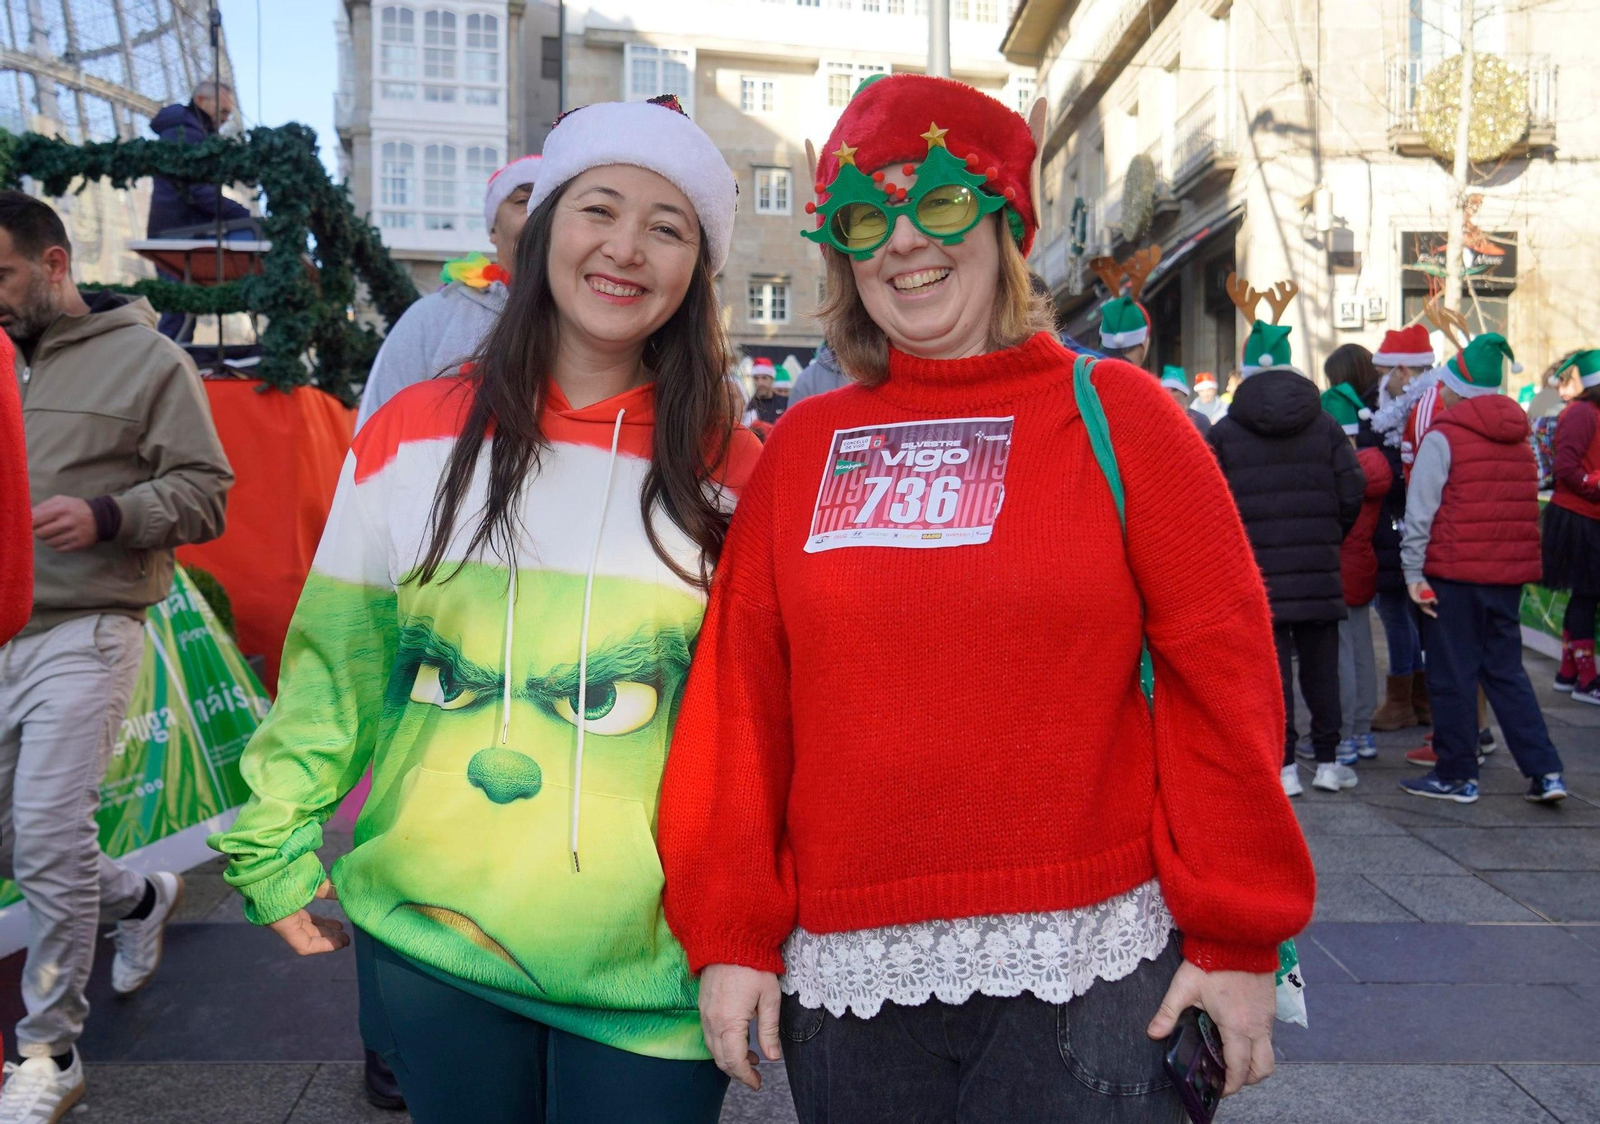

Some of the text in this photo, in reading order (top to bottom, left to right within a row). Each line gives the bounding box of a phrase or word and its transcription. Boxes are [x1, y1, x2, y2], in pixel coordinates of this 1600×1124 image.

[843, 438, 869, 446] CONCELLO
[901, 440, 961, 449] SILVESTRE
[881, 447, 969, 473] vigo
[853, 475, 962, 525] 736
